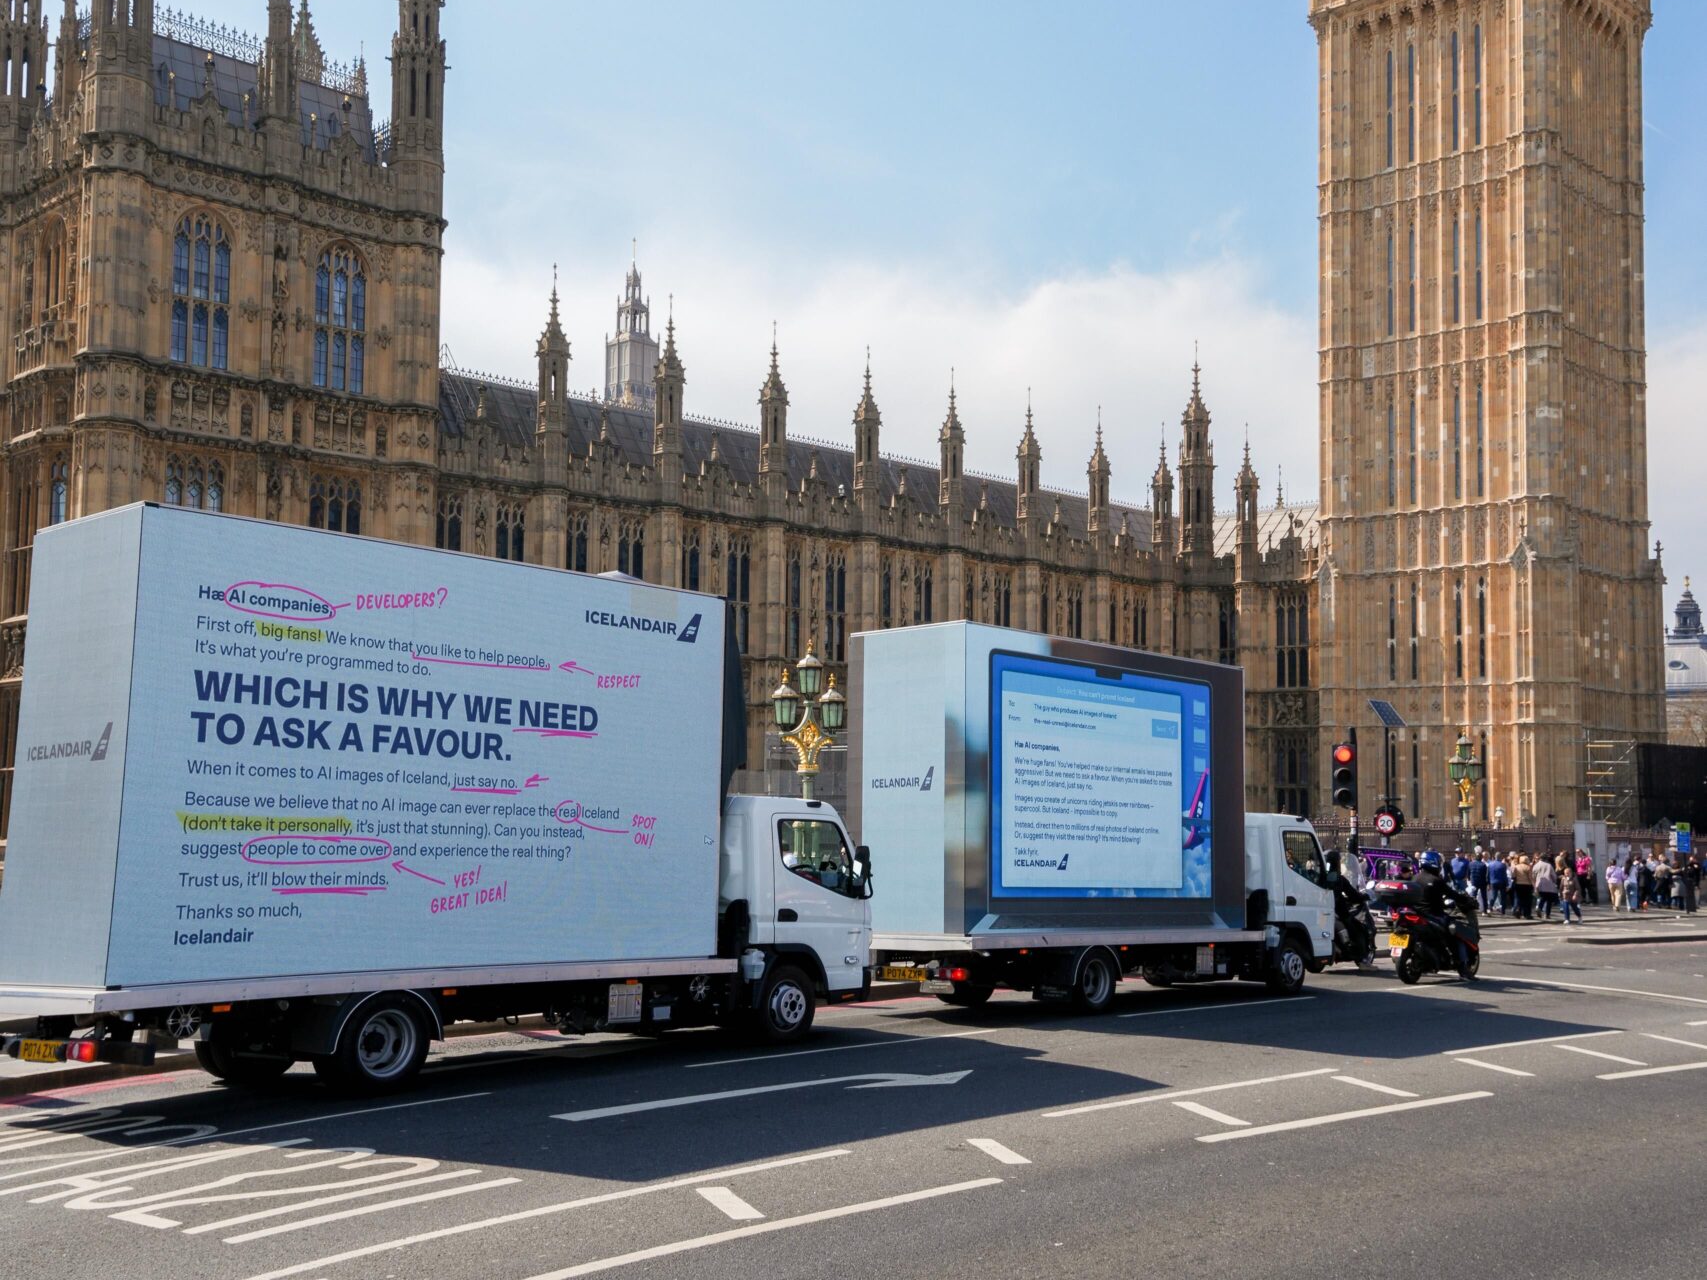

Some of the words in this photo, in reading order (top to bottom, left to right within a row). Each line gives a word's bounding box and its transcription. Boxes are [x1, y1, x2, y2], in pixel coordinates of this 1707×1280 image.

[198, 584, 225, 601] Hæ
[228, 589, 245, 604] AI
[249, 594, 332, 617] companies,
[356, 588, 447, 609] DEVELOPERS?
[585, 609, 677, 635] ICELANDAIR
[196, 615, 231, 632] First
[233, 620, 257, 637] off,
[261, 622, 283, 642] big
[286, 625, 321, 642] fans!
[325, 630, 347, 645] We
[350, 632, 386, 649] know
[388, 637, 413, 652] that
[415, 643, 438, 656] you
[441, 643, 461, 658] like
[464, 647, 476, 660] to
[478, 647, 504, 666] help
[506, 654, 550, 668] people.
[195, 638, 216, 655] It's
[219, 642, 256, 658] what
[259, 648, 303, 663] you're
[306, 654, 394, 672] programmed
[396, 661, 409, 674] to
[411, 661, 431, 676] do.
[597, 675, 640, 688] RESPECT
[193, 669, 328, 710] WHICH
[336, 682, 369, 714] IS
[376, 686, 457, 720] WHY
[463, 693, 512, 725] WE
[518, 699, 598, 732] NEED
[190, 711, 245, 745] TO
[252, 716, 332, 750] ASK
[337, 722, 364, 752] A
[371, 724, 511, 761] FAVOUR.
[27, 743, 92, 762] ICELANDAIR
[1014, 740, 1024, 748] Hæ
[1024, 741, 1031, 749] AI
[1030, 743, 1060, 752] companies,
[187, 759, 231, 775] When
[235, 761, 245, 776] it
[248, 765, 296, 779] comes
[299, 766, 314, 779] to
[316, 765, 331, 780] AI
[335, 766, 384, 785] images
[386, 769, 400, 783] of
[402, 770, 450, 788] Iceland,
[452, 772, 475, 789] just
[478, 777, 498, 788] say
[500, 778, 517, 788] no.
[1014, 756, 1030, 765] We're
[1030, 758, 1043, 768] huge
[1043, 759, 1056, 767] fans!
[1057, 760, 1073, 769] You've
[1073, 761, 1091, 771] helped
[1090, 764, 1105, 772] make
[1112, 766, 1131, 774] internal
[1130, 767, 1146, 775] emails
[872, 777, 920, 789] ICELANDAIR
[1014, 768, 1044, 777] aggressive!
[1044, 769, 1054, 777] But
[1094, 773, 1110, 782] favour.
[1110, 774, 1124, 783] When
[1138, 777, 1153, 785] asked
[1021, 779, 1040, 788] images
[1046, 780, 1066, 789] Iceland,
[1066, 781, 1076, 790] just
[1076, 783, 1085, 791] say
[184, 791, 250, 807] Because
[253, 796, 275, 808] we
[278, 793, 329, 810] believe
[331, 795, 359, 810] that
[361, 800, 378, 811] no
[381, 797, 395, 811] AI
[398, 798, 437, 816] image
[439, 803, 462, 813] can
[464, 804, 491, 815] ever
[493, 803, 536, 819] replace
[538, 804, 556, 817] the
[558, 806, 579, 818] real
[581, 806, 620, 819] Iceland
[183, 815, 227, 834] (don't
[230, 816, 262, 831] take
[265, 817, 275, 831] it
[278, 818, 352, 836] personally,
[356, 819, 374, 833] it's
[375, 819, 401, 837] just
[403, 820, 428, 835] that
[430, 822, 490, 839] stunning).
[493, 823, 517, 836] Can
[519, 826, 540, 840] you
[542, 824, 585, 840] instead,
[632, 815, 656, 829] SPOT
[1051, 822, 1064, 830] them
[1070, 823, 1090, 831] millions
[1105, 825, 1123, 834] photos
[1121, 825, 1128, 833] of
[1127, 825, 1145, 834] Iceland
[1379, 819, 1393, 827] 20
[634, 832, 653, 845] ON!
[180, 841, 243, 859] suggest
[248, 840, 298, 859] people
[301, 842, 316, 856] to
[318, 844, 357, 856] come
[359, 845, 388, 856] over
[392, 842, 417, 857] and
[419, 843, 488, 860] experience
[490, 844, 510, 858] the
[512, 845, 533, 858] real
[535, 845, 571, 862] thing?
[1014, 859, 1057, 867] ICELANDAIR
[178, 872, 219, 887] Trust
[222, 875, 243, 888] us,
[247, 871, 268, 886] it'll
[271, 871, 307, 886] blow
[309, 871, 342, 886] their
[344, 871, 389, 885] minds.
[454, 865, 482, 888] YES!
[431, 893, 468, 914] GREAT
[475, 880, 508, 907] IDEA!
[175, 903, 233, 920] Thanks
[237, 906, 254, 918] so
[258, 901, 302, 918] much,
[173, 927, 254, 945] Icelandair
